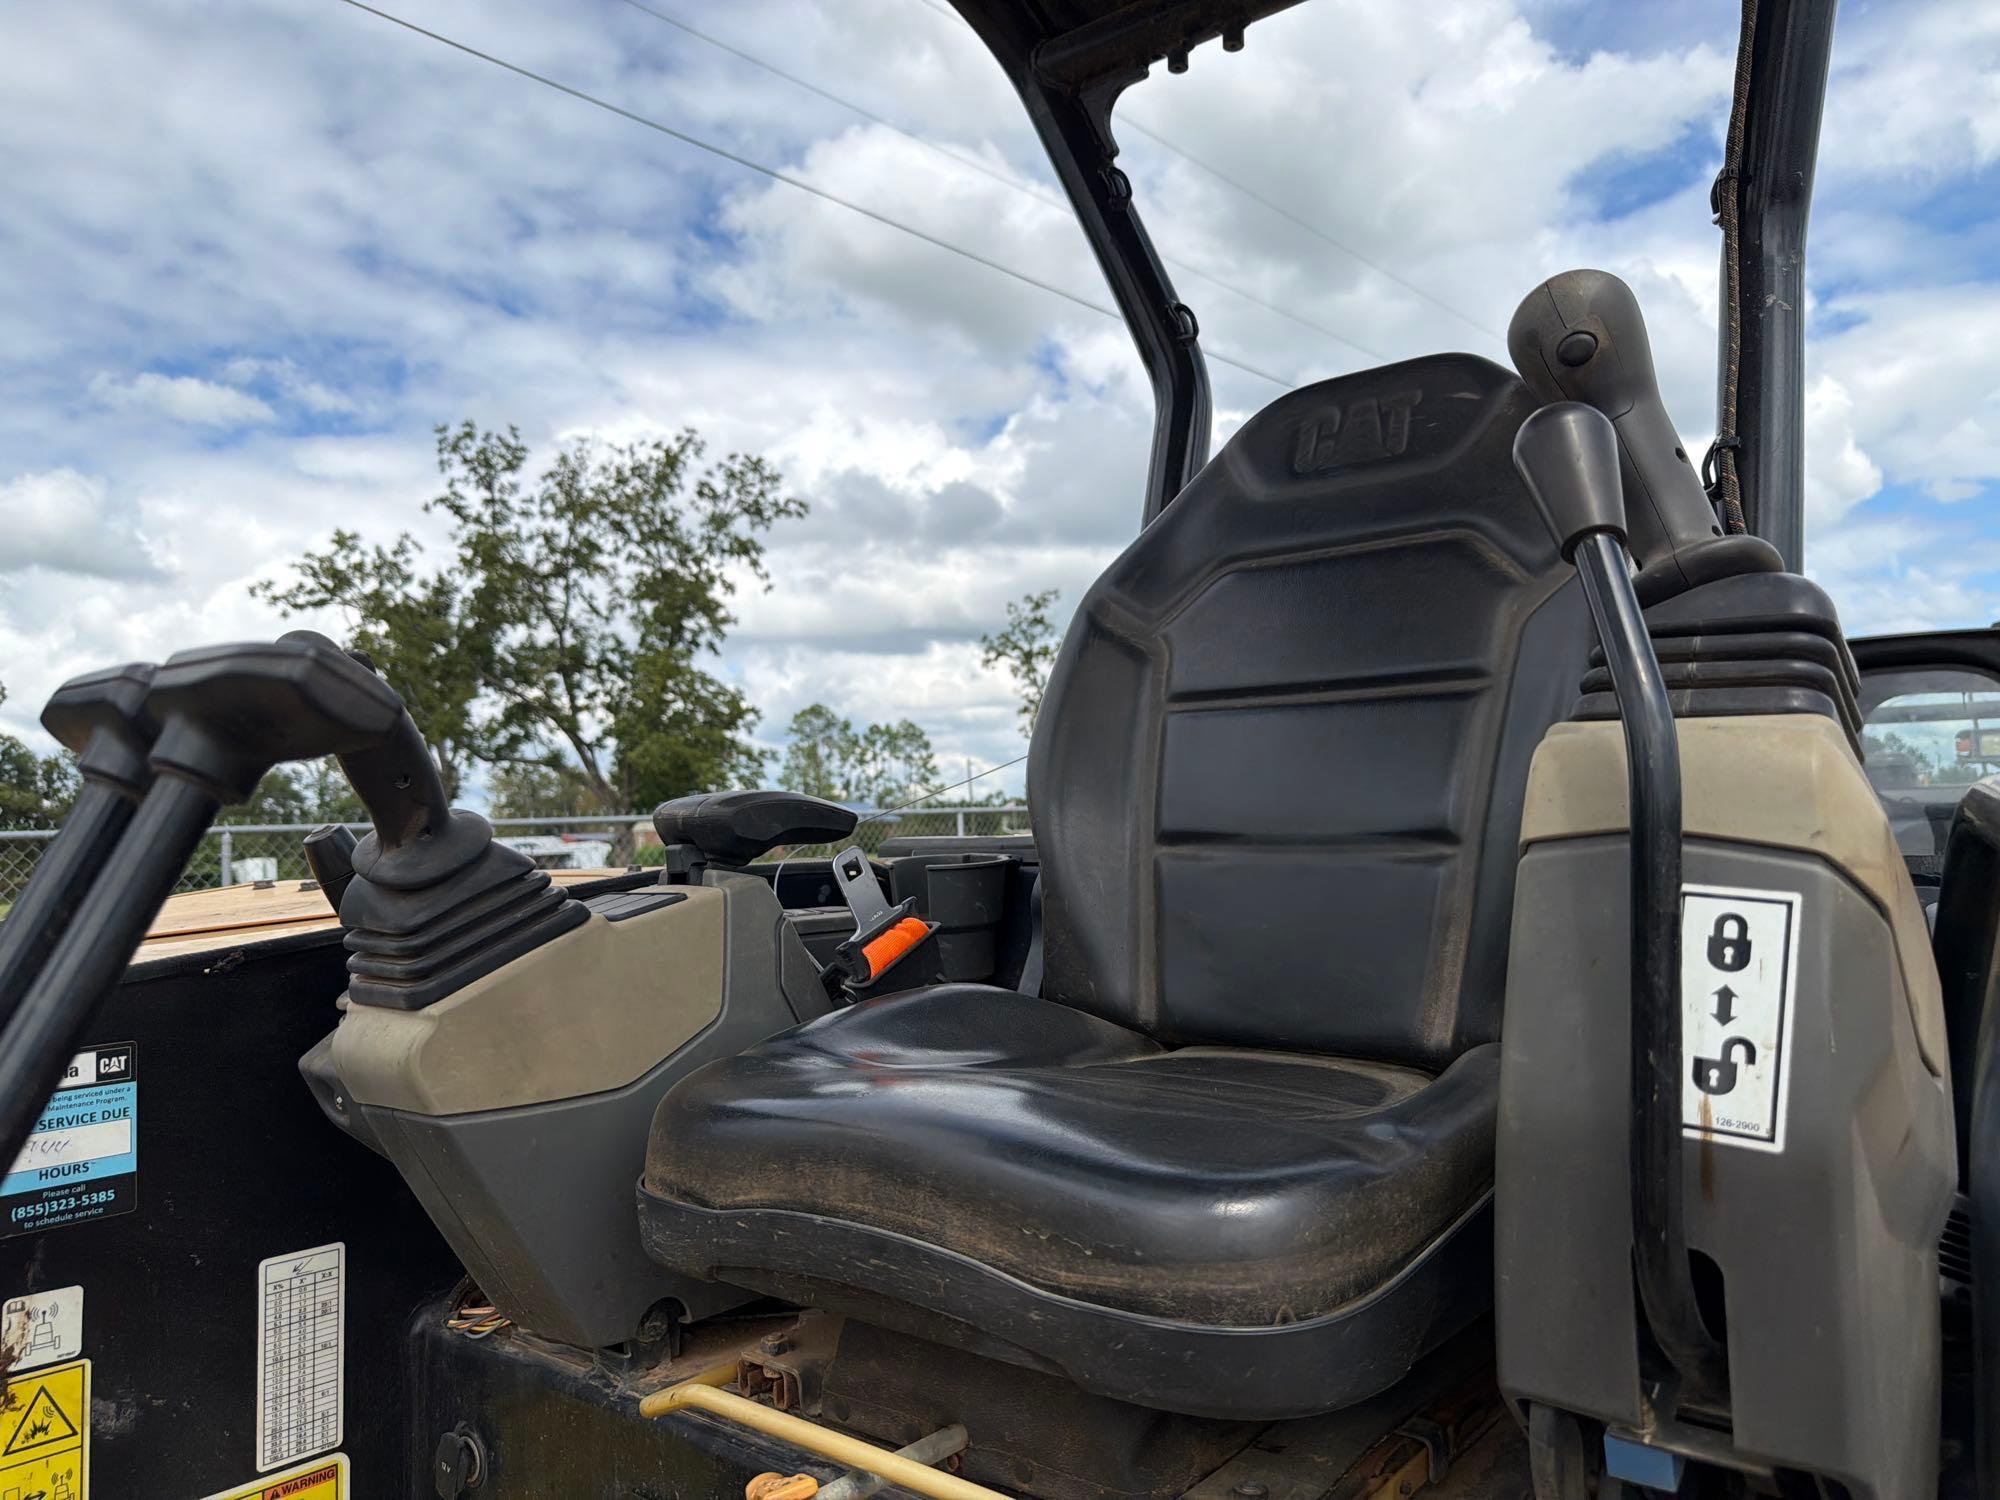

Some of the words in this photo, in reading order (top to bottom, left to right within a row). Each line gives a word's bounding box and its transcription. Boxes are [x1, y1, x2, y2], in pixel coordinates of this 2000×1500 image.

[1294, 390, 1424, 473] CAT
[99, 1055, 128, 1074] CAT
[52, 1094, 73, 1103] being
[73, 1090, 103, 1100] serviced
[105, 1087, 125, 1095] under
[47, 1100, 94, 1112] Maintenance
[38, 1111, 97, 1130] SERVICE
[101, 1106, 131, 1120] DUE
[1715, 1116, 1760, 1132] 126-2900
[39, 1162, 90, 1181] HOURS
[42, 1187, 70, 1199] Please
[71, 1183, 86, 1194] call
[10, 1189, 116, 1222] (855)323-5385
[23, 1220, 34, 1229] to
[35, 1212, 73, 1228] schedule
[75, 1206, 104, 1219] service
[281, 1467, 336, 1495] WARNING
